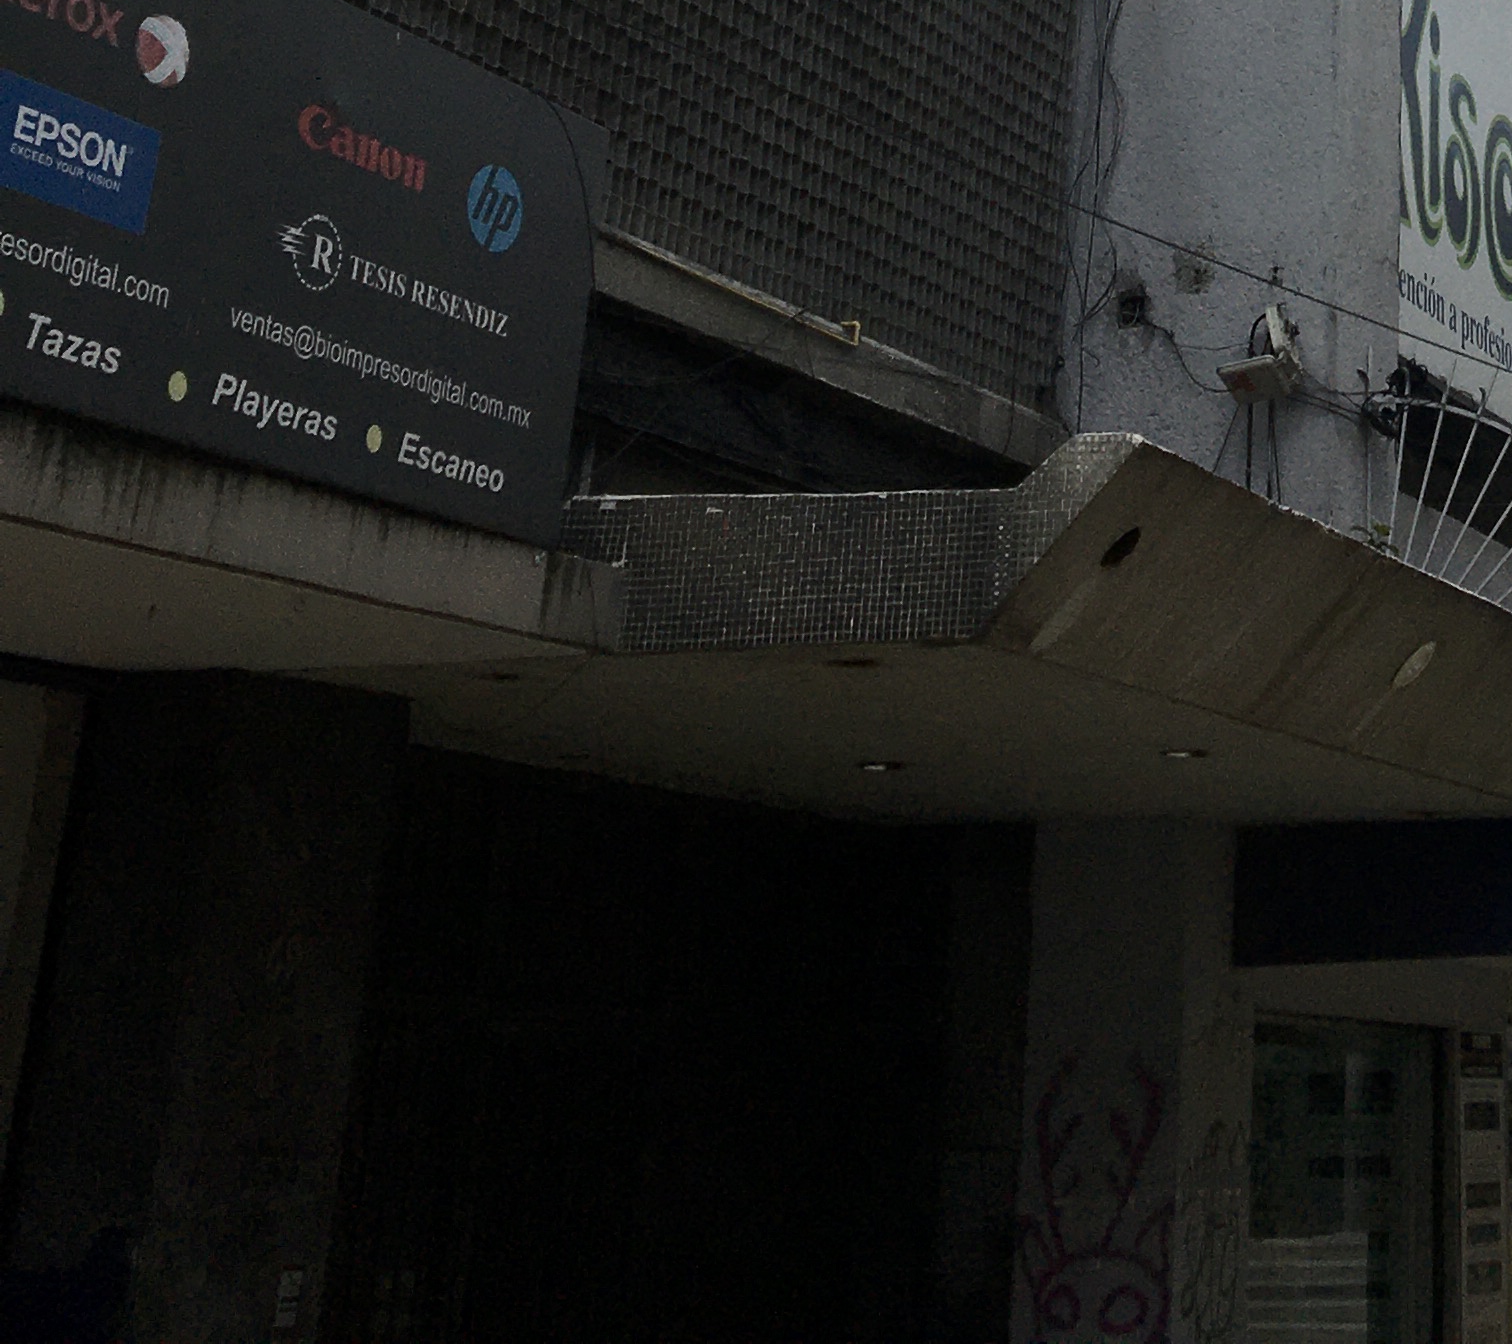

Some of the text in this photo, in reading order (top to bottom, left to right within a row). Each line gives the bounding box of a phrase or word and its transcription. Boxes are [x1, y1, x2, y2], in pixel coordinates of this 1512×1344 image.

[9, 141, 122, 193] EXCEED YOUR VISION
[13, 104, 127, 177] EPSON
[298, 104, 427, 193] Canon
[472, 164, 520, 250] hp
[0, 230, 170, 309] esordigital.com
[349, 254, 511, 338] TESIS RESENDIZ
[1449, 303, 1458, 334] a
[26, 312, 506, 493] Tazas Playeras Escaneo
[230, 306, 533, 430] ventas@bioimpresordigital.com.mx
